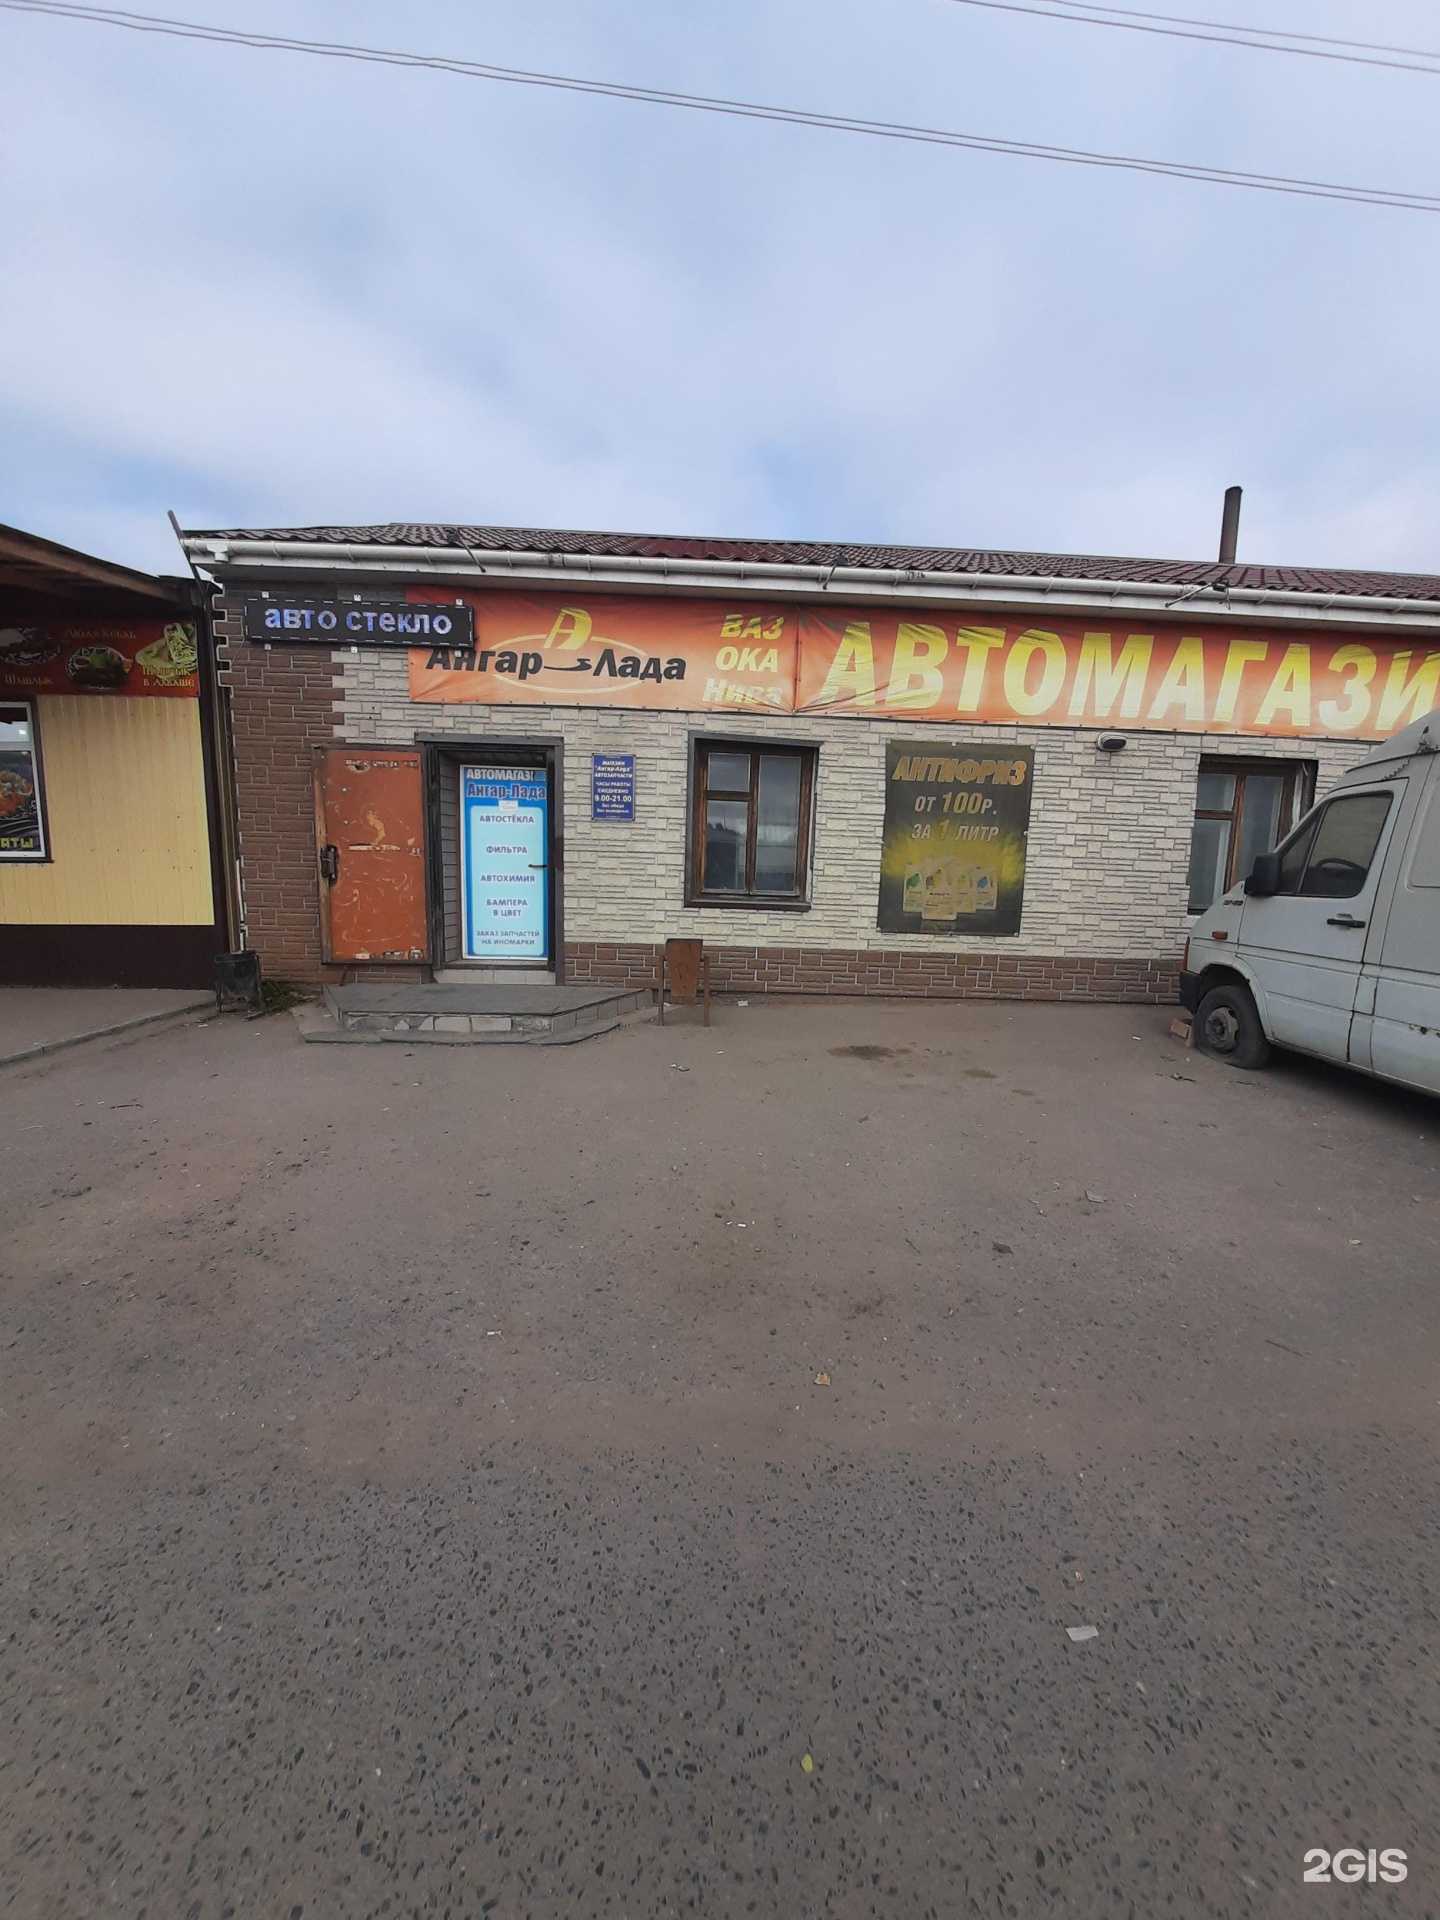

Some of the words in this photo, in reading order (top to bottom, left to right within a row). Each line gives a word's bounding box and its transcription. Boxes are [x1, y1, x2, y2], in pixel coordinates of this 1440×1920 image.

[265, 607, 337, 632] авто
[346, 610, 453, 636] стекло
[720, 614, 785, 640] ВАЗ
[426, 648, 544, 680] Ангар
[593, 648, 687, 684] Лада
[715, 646, 779, 673] ОКА
[892, 755, 1027, 786] АНТИФРИЗ
[466, 781, 547, 801] Ангар-Лада
[914, 795, 937, 812] ОТ
[911, 823, 932, 840] ЗА
[955, 824, 1000, 841] ЛИТР
[486, 845, 528, 854] ФИЛЬТРА
[480, 874, 535, 883] АВТОХИМИЯ
[486, 898, 528, 907] БАМПЕРА
[500, 909, 522, 918] ЦВЕТ
